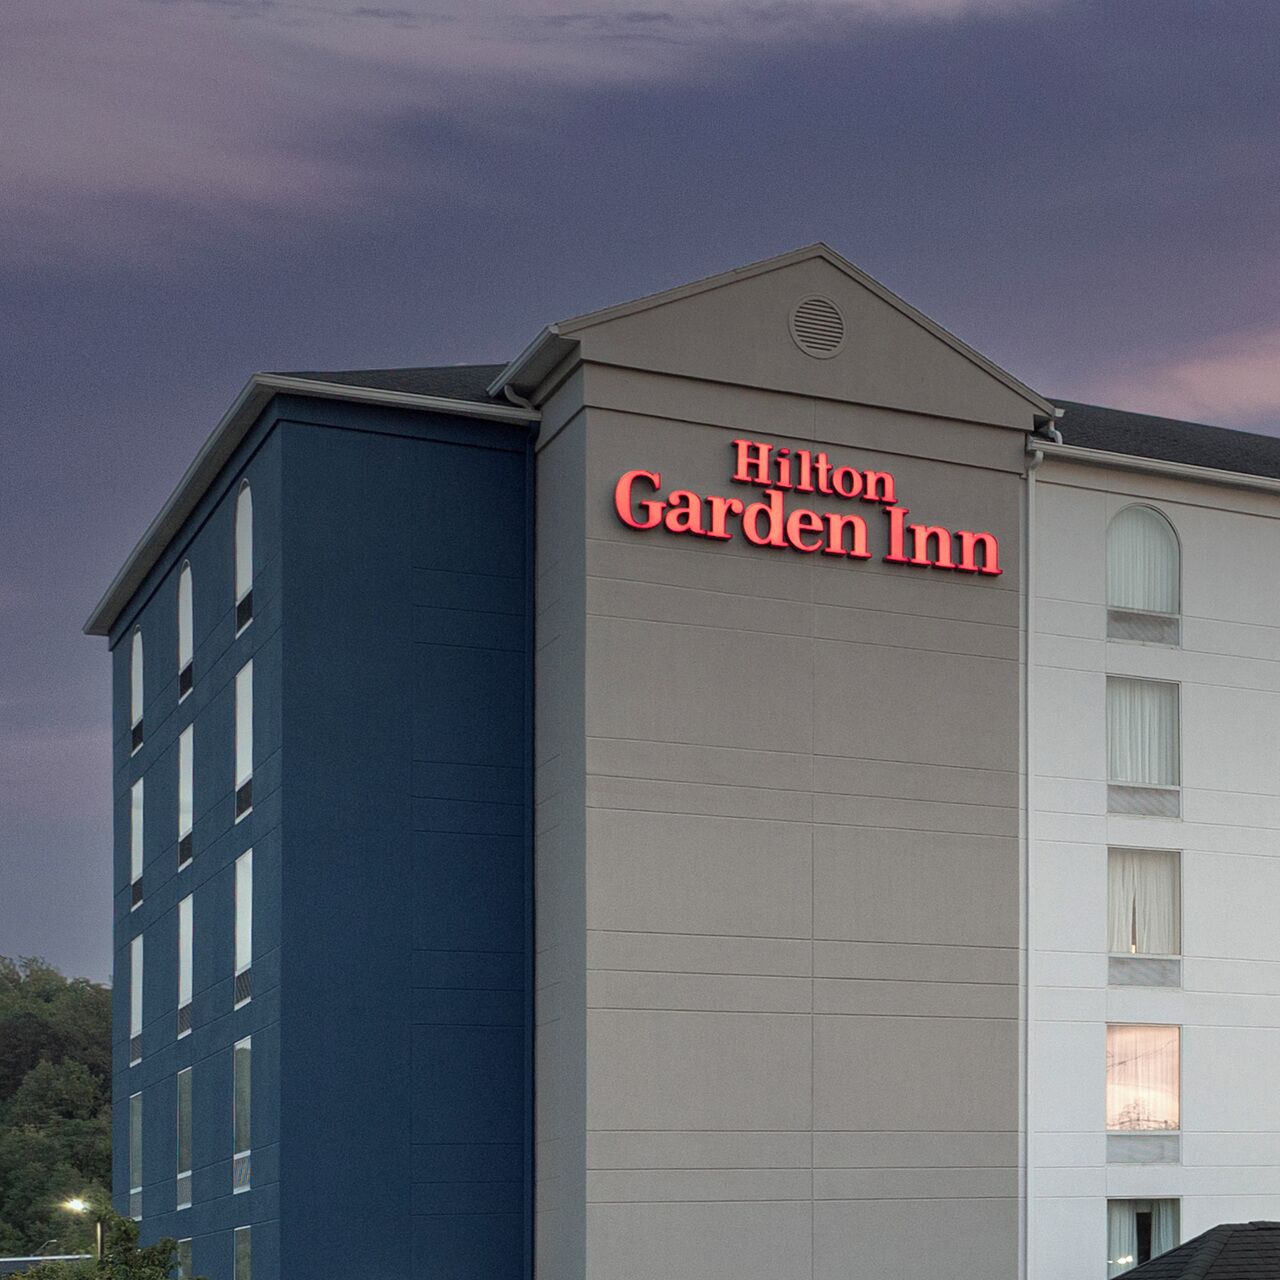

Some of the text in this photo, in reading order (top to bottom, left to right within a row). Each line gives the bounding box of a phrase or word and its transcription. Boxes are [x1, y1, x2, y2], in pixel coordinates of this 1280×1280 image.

[731, 438, 899, 504] Hilton
[614, 468, 1003, 577] Garden Inn
